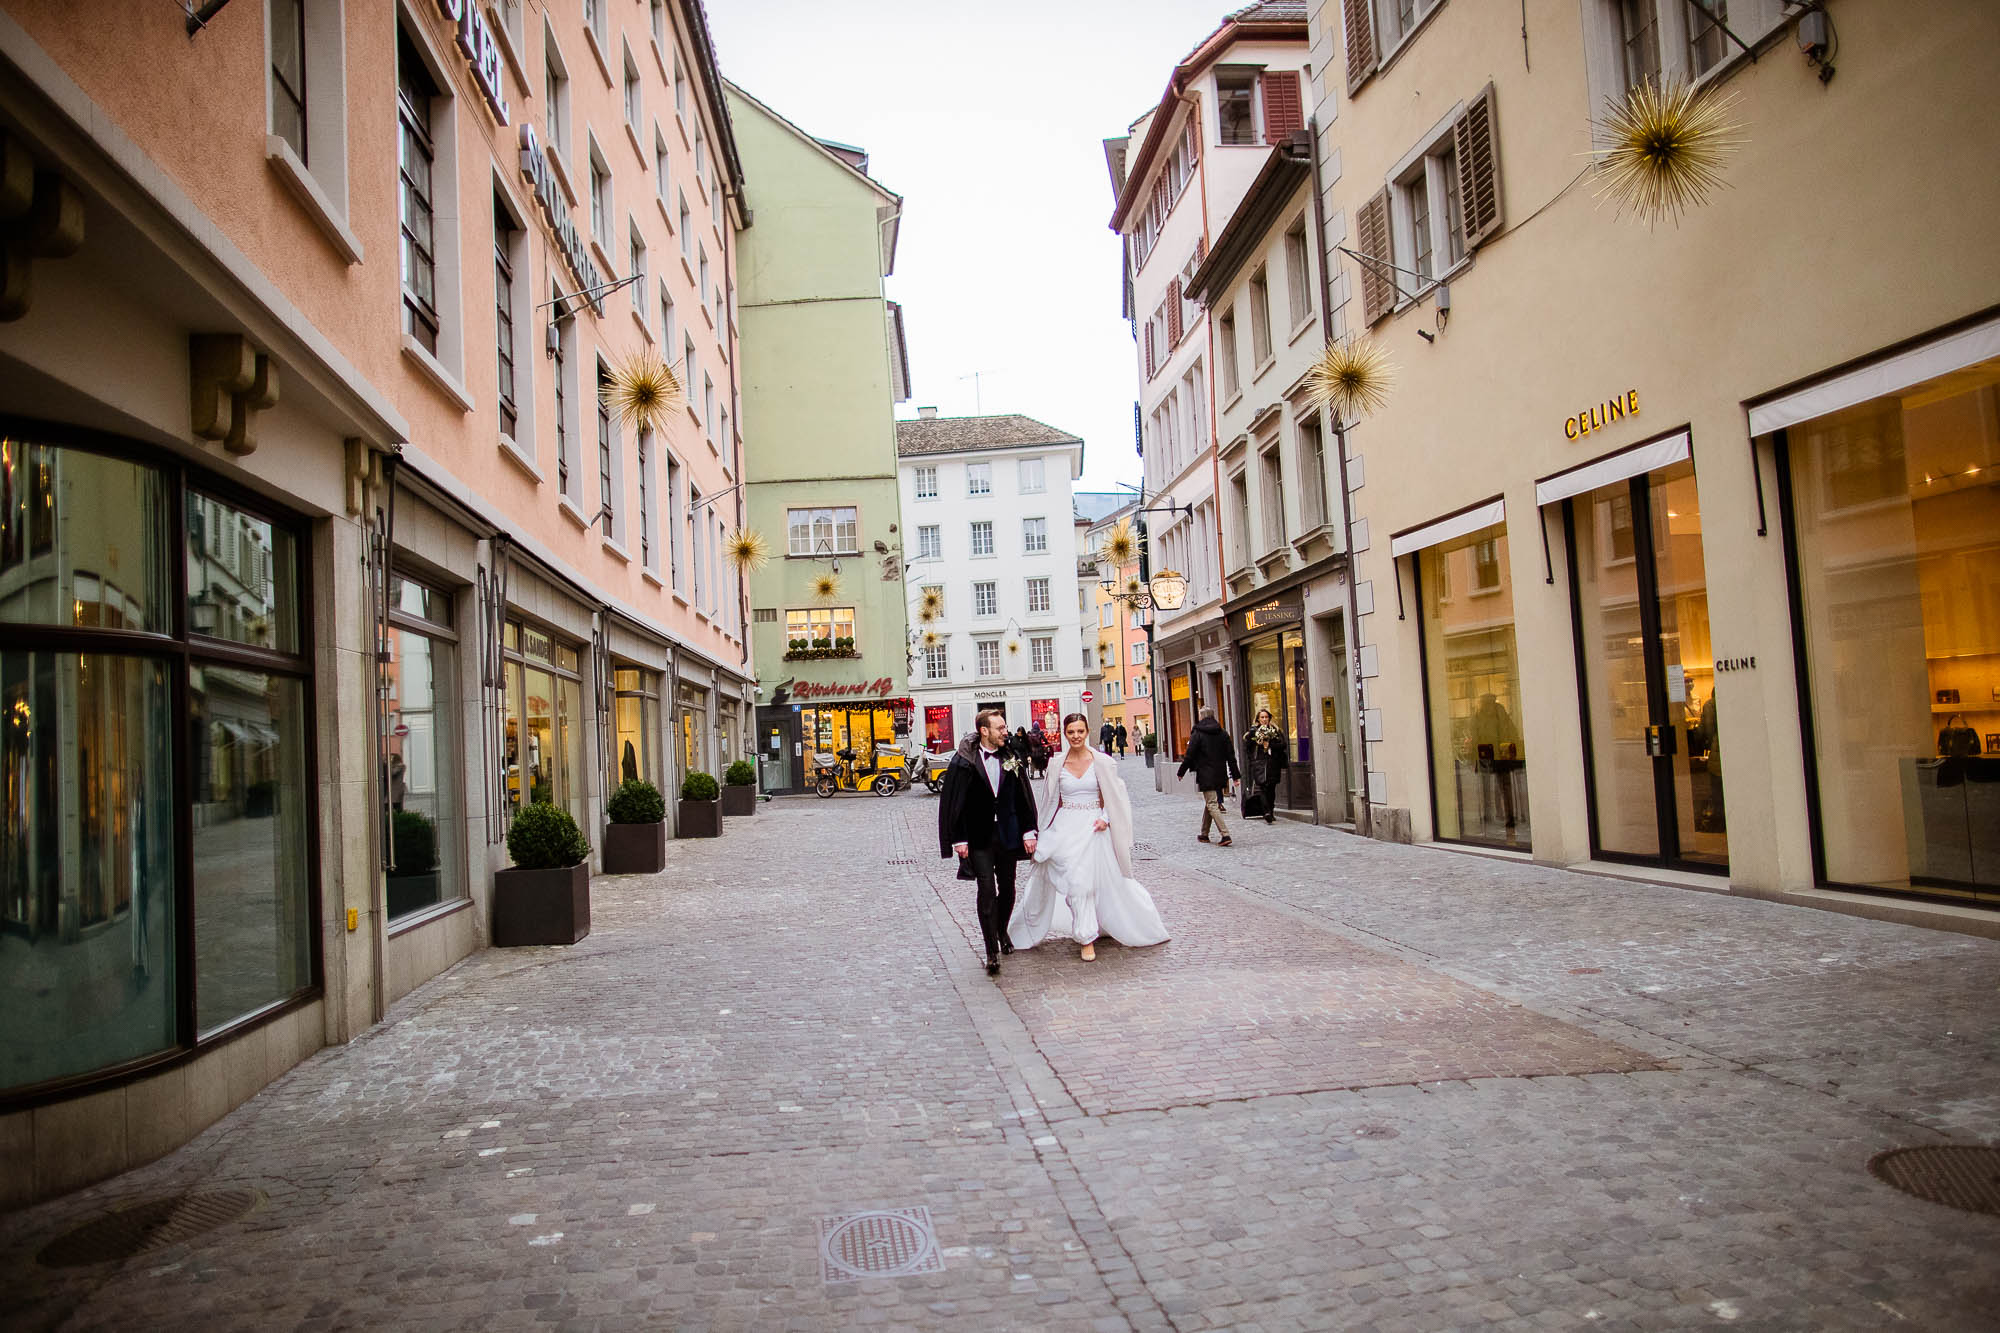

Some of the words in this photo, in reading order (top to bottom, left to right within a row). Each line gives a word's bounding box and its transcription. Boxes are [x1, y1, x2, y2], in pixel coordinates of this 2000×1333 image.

[1564, 388, 1640, 441] CELINE
[1716, 656, 1757, 672] CELINE
[974, 690, 1007, 699] MONCLER
